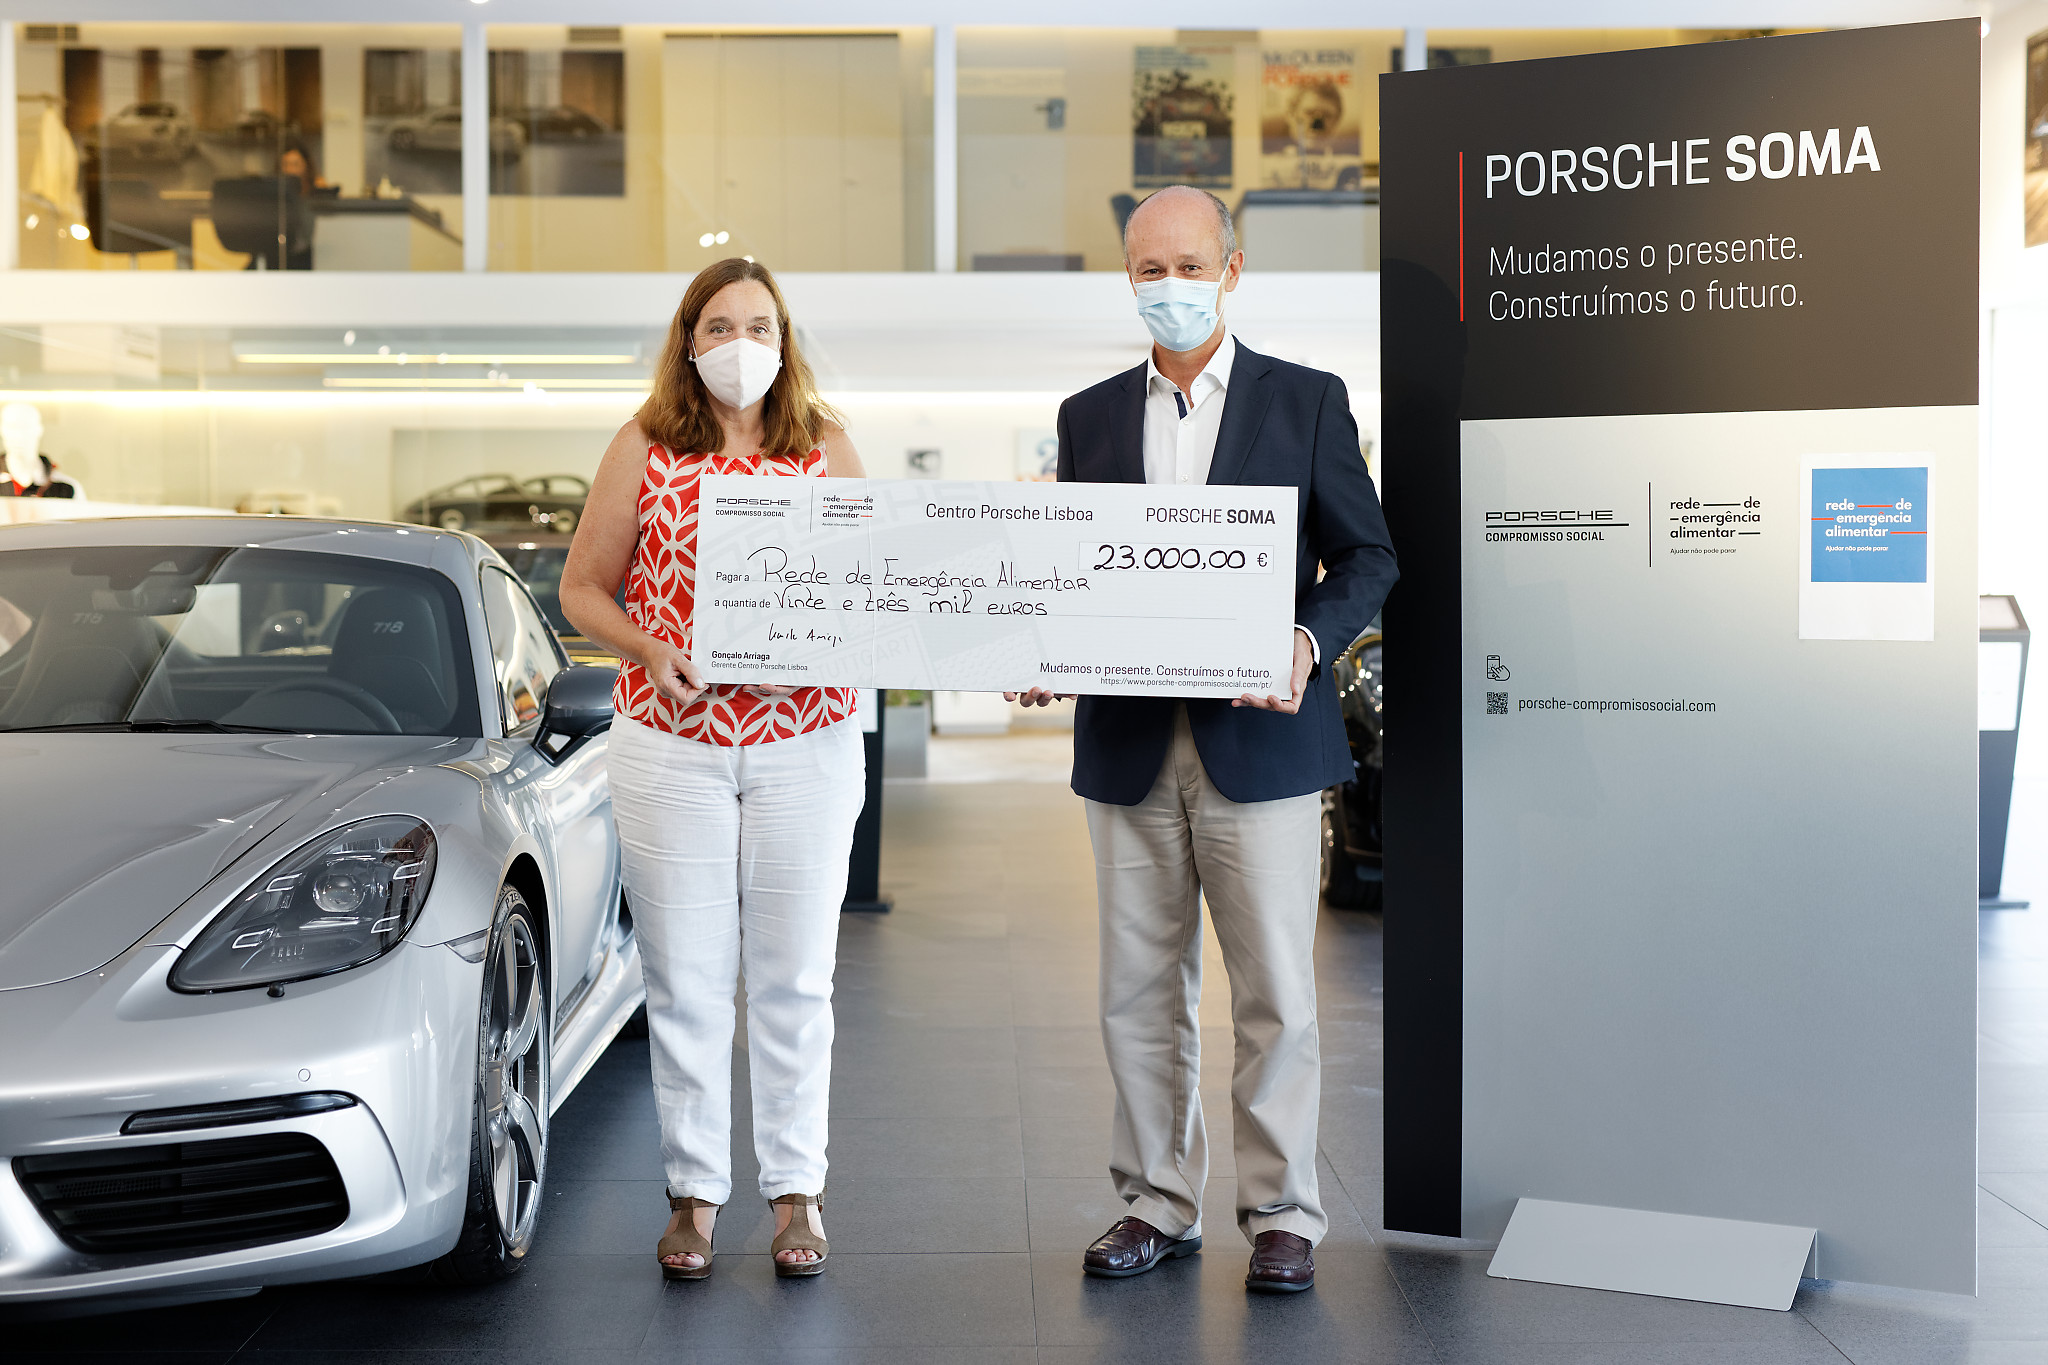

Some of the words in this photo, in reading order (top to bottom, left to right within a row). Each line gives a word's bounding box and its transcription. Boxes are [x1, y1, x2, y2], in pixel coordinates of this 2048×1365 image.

[1487, 138, 1709, 198] PORSCHE
[1726, 126, 1881, 181] SOMA
[1490, 244, 1628, 276] Mudamos
[1641, 246, 1655, 267] o
[1669, 234, 1802, 274] presente.
[1490, 285, 1668, 320] Construímos
[1681, 290, 1695, 311] o
[1707, 280, 1803, 310] futuro.
[829, 503, 873, 512] emergência
[1671, 497, 1700, 509] rede
[1744, 496, 1760, 508] de
[1826, 498, 1855, 510] rede
[1895, 498, 1912, 510] de
[822, 511, 860, 519] alimentar
[927, 504, 975, 518] Centro
[981, 505, 1039, 519] Porsche
[1046, 506, 1092, 520] Lisboa
[1147, 508, 1221, 523] PORSCHE
[1227, 509, 1275, 524] SOMA
[1486, 510, 1613, 521] PORSCHE
[1681, 511, 1760, 526] emergência
[1836, 512, 1912, 526] emergência
[1486, 532, 1563, 542] COMPROMISSO
[1567, 532, 1604, 541] SOCIAL
[1670, 526, 1736, 538] alimentar
[1825, 525, 1889, 537] alimentar
[1094, 545, 1245, 570] 23.000,00
[1257, 553, 1267, 567] €
[747, 547, 830, 585] Rede
[845, 561, 872, 585] de
[716, 572, 742, 583] Pagar
[723, 599, 756, 609] quantia
[760, 599, 770, 608] de
[774, 584, 826, 610] Vinte
[842, 598, 853, 611] e
[929, 590, 973, 614] mil
[373, 621, 405, 634] 718
[712, 651, 742, 660] Gonçalo
[744, 652, 770, 661] Arriaga
[1040, 663, 1091, 673] Mudamos
[1105, 666, 1153, 676] presente.
[1157, 665, 1224, 677] Construímos
[1237, 667, 1271, 678] futuro.
[1101, 677, 1272, 689] https://www.porsche-compromisosocial.com/pt/
[1519, 697, 1715, 713] porsche-compromisosocial.com
